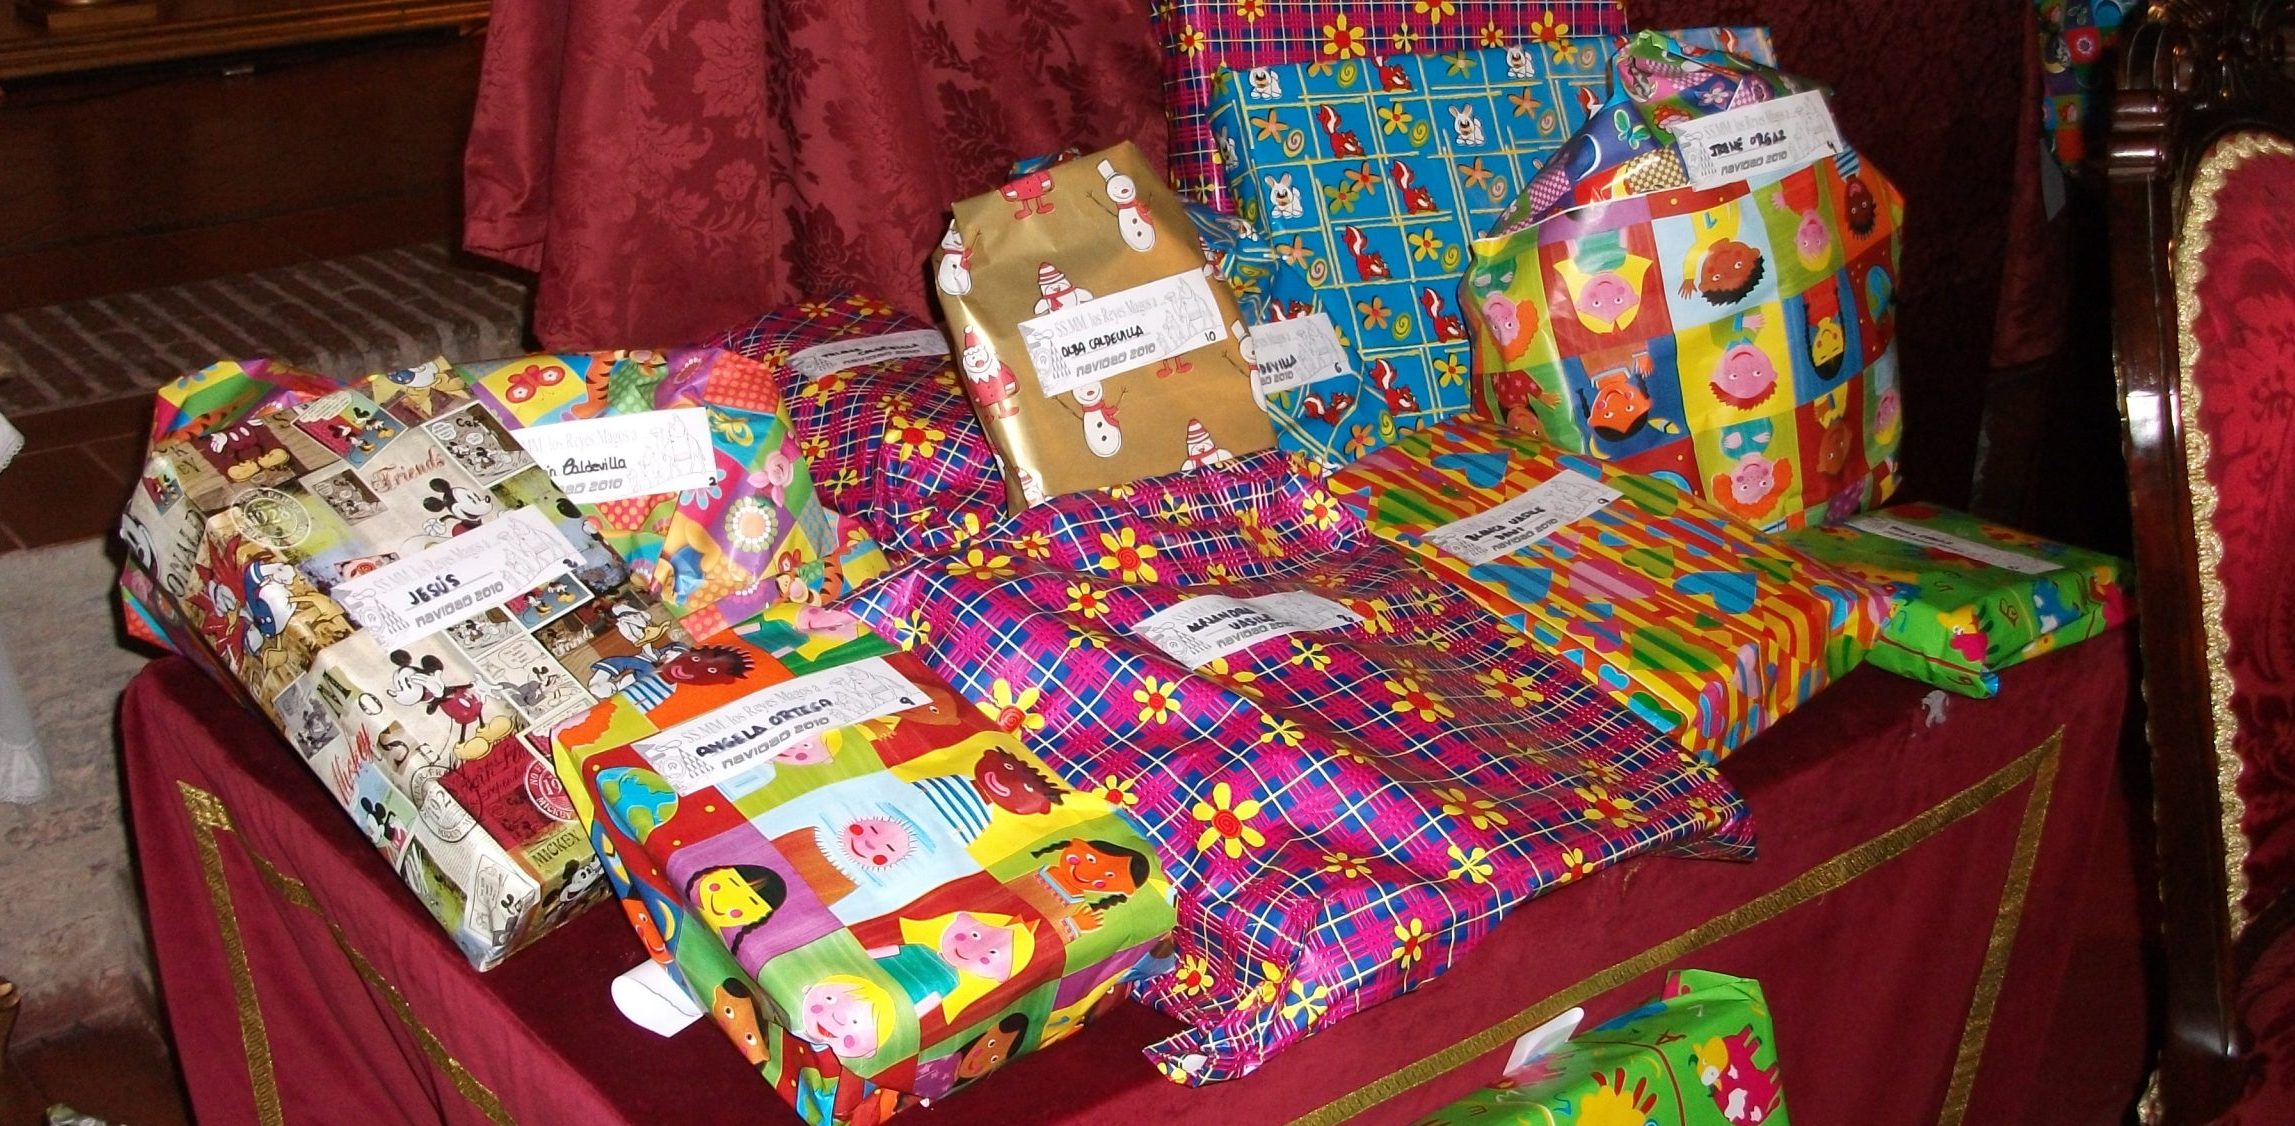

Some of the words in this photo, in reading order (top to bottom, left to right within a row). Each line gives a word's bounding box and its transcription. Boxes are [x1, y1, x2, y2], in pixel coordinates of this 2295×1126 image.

[1765, 150, 1787, 164] 2010
[1088, 324, 1144, 350] CALDEVILLA
[1204, 331, 1217, 342] 10
[1130, 342, 1156, 361] 2010
[1273, 370, 1294, 383] 2010
[371, 445, 445, 493] Friends
[562, 456, 628, 477] Caldevilla
[589, 478, 623, 492] 2010
[708, 476, 717, 486] 2
[1535, 518, 1558, 534] 2010
[166, 509, 206, 598] ONALD
[408, 573, 461, 606] JESÚS
[475, 581, 504, 602] 2010
[743, 698, 775, 718] Reyes
[774, 687, 813, 704] Magos
[696, 724, 768, 759] ANGELA
[769, 698, 834, 727] ORTEGA
[793, 716, 831, 735] 2010
[542, 777, 563, 797] 19
[531, 830, 581, 867] MICKEY
